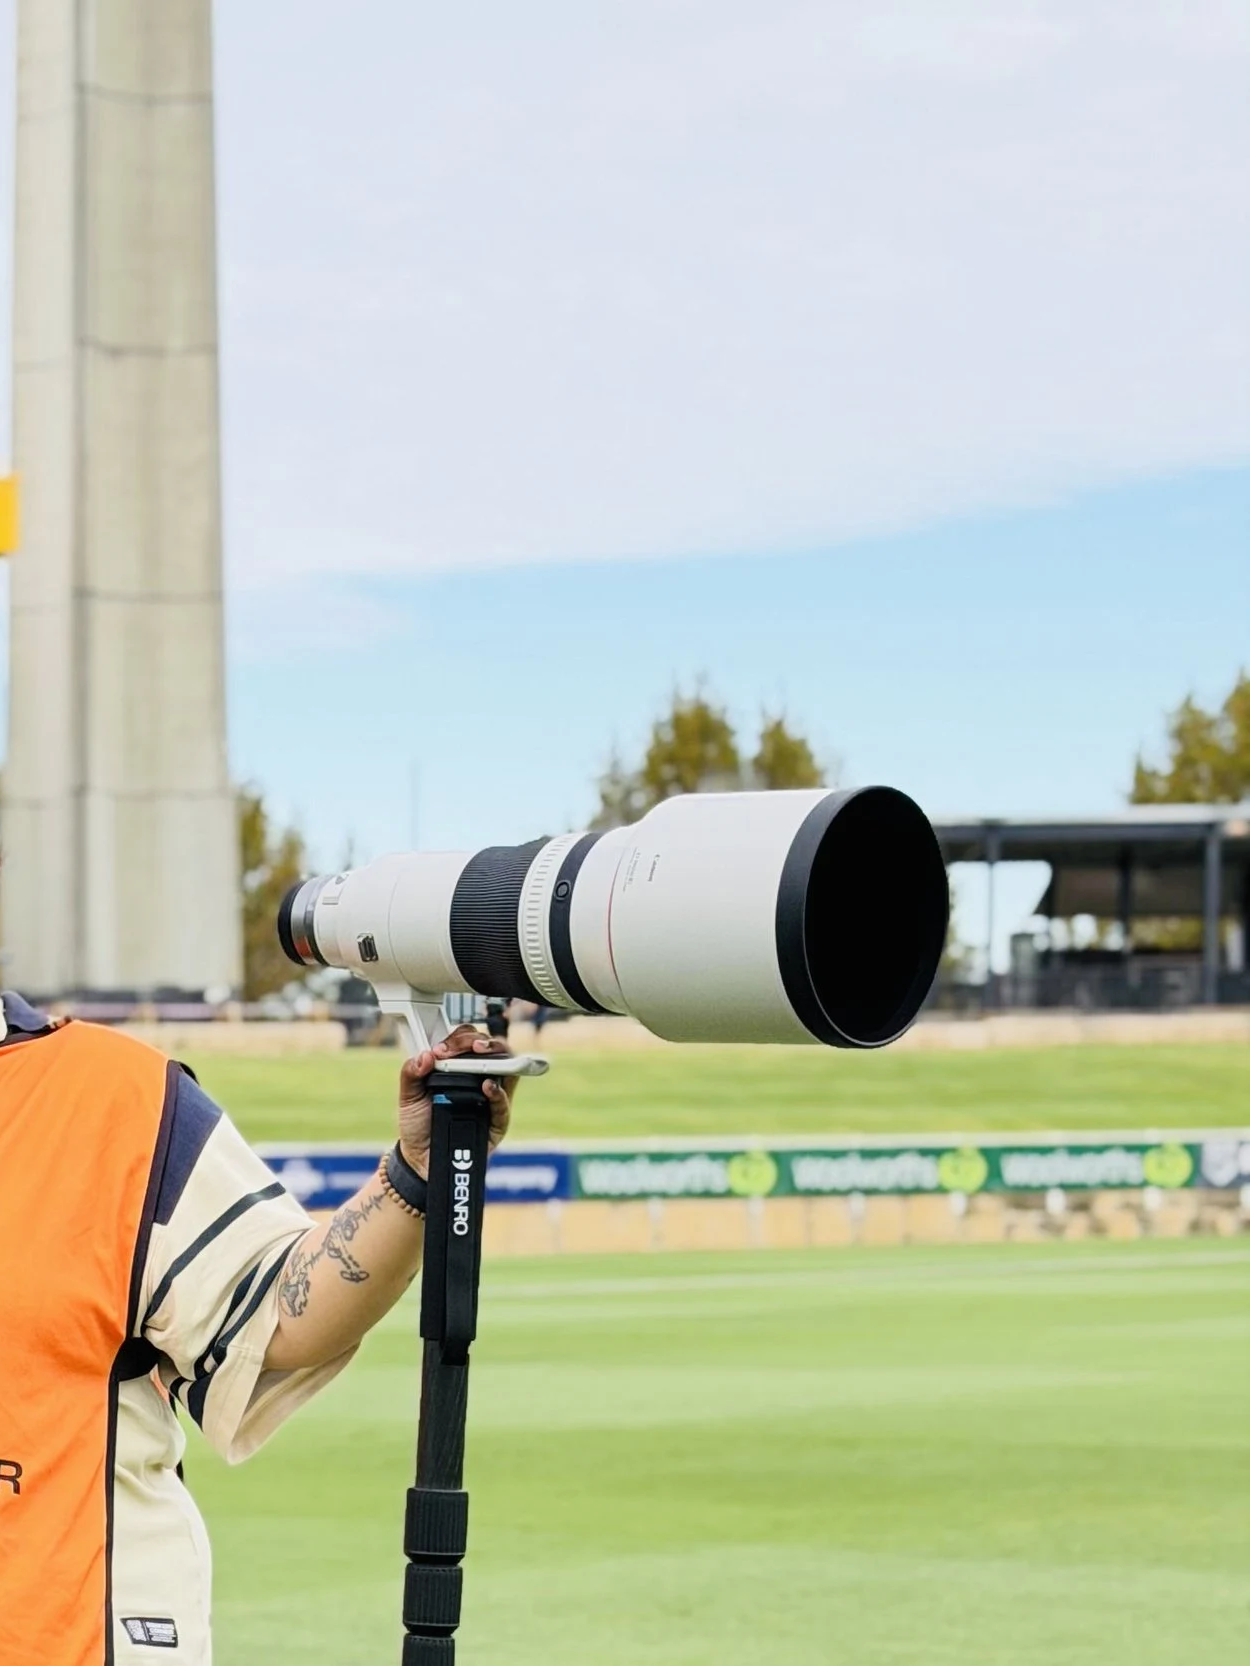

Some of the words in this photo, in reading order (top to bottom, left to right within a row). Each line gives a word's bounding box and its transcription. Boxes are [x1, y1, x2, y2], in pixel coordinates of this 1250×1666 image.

[578, 1157, 729, 1196] Woolworths
[791, 1153, 938, 1193] Woolworths
[1000, 1148, 1144, 1187] Woolworths
[452, 1173, 471, 1236] BENRO
